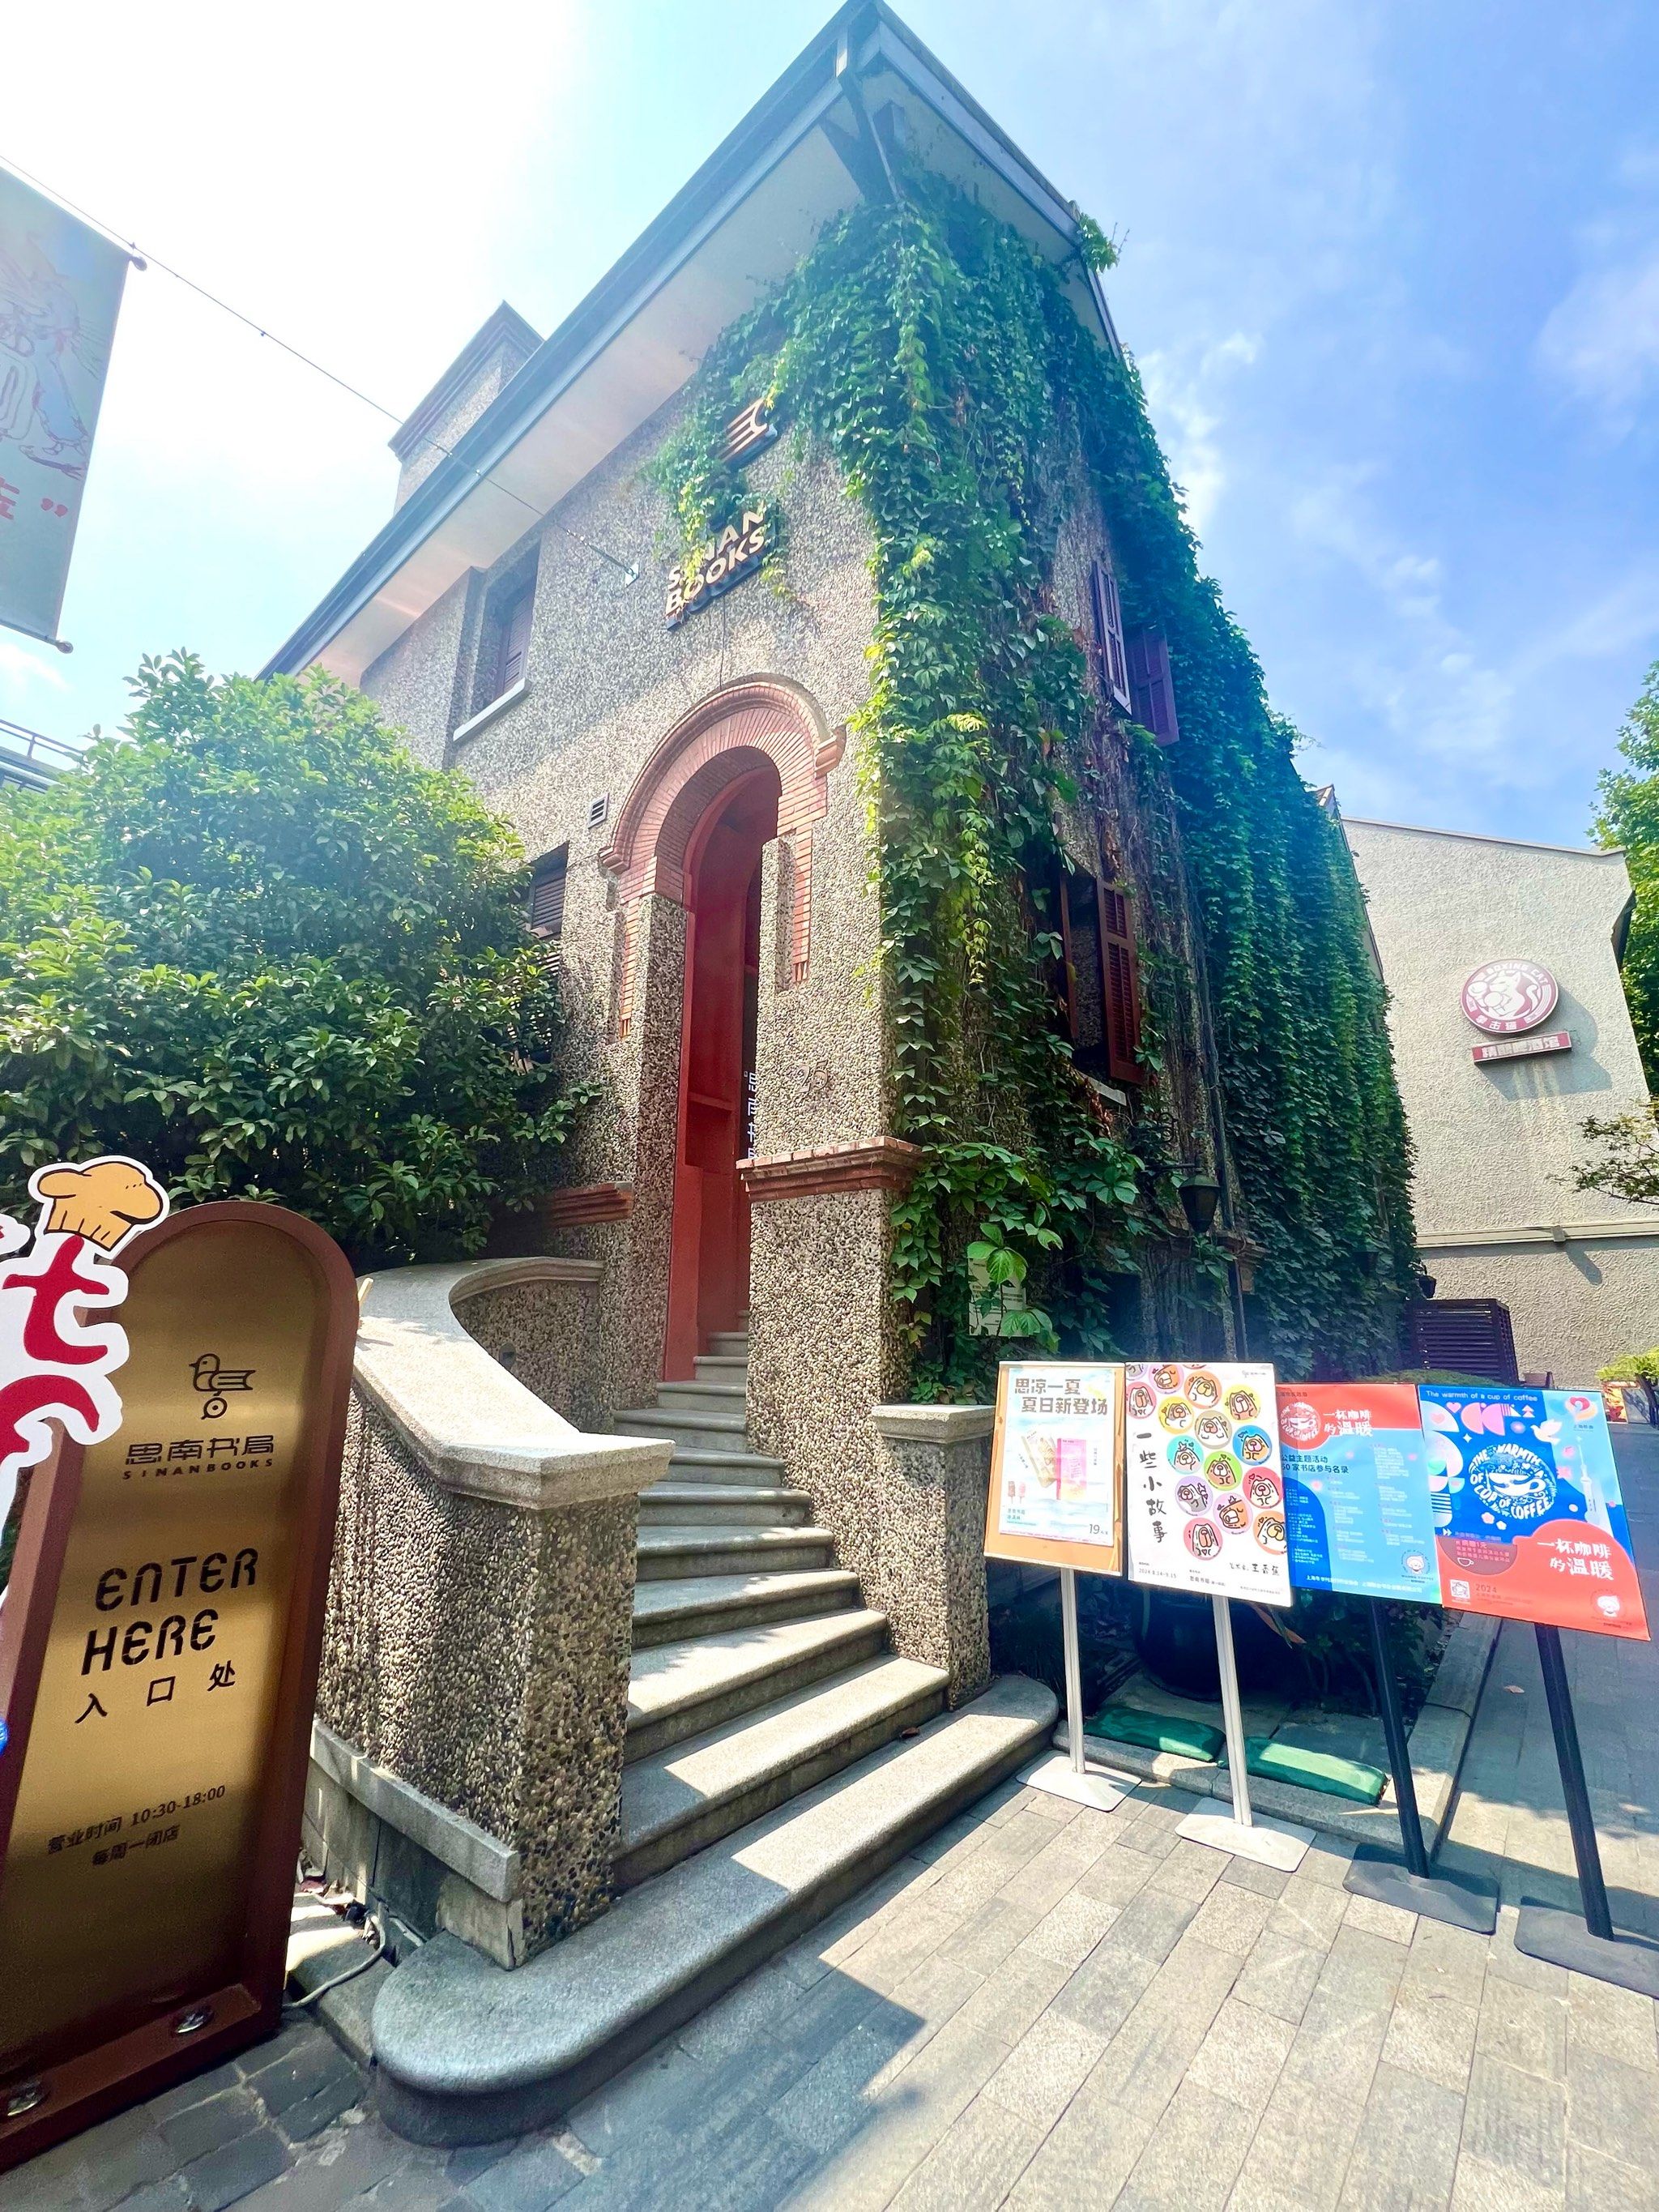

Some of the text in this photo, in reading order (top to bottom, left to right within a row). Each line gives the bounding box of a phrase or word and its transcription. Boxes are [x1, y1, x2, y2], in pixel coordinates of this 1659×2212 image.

[665, 526, 765, 615] BOOKS
[1486, 963, 1549, 986] BOXING CAT
[795, 1060, 829, 1094] 25
[1014, 1377, 1081, 1394] 思凉一夏
[1021, 1396, 1108, 1416] 夏日新登场
[1513, 1394, 1538, 1402] coffee
[1324, 1409, 1372, 1421] 一杯咖啡
[1324, 1420, 1374, 1437] 的温暖
[126, 1434, 275, 1465] 思南书局
[1472, 1443, 1542, 1467] THE WARMTH
[123, 1458, 273, 1480] SINANBOOKS
[1469, 1472, 1485, 1485] OF
[1136, 1432, 1168, 1544] 一些小故事
[1473, 1484, 1554, 1520] CUP OF COFFEE
[1089, 1523, 1100, 1535] 19
[1537, 1538, 1612, 1560] 一杯咖啡
[95, 1548, 258, 1612] ENTER
[1549, 1557, 1614, 1581] 的温暖
[1475, 1582, 1498, 1595] 2024
[81, 1608, 219, 1676] HERE
[75, 1659, 236, 1724] 入口处
[48, 1784, 226, 1855] 营业时间 10:30-18:00
